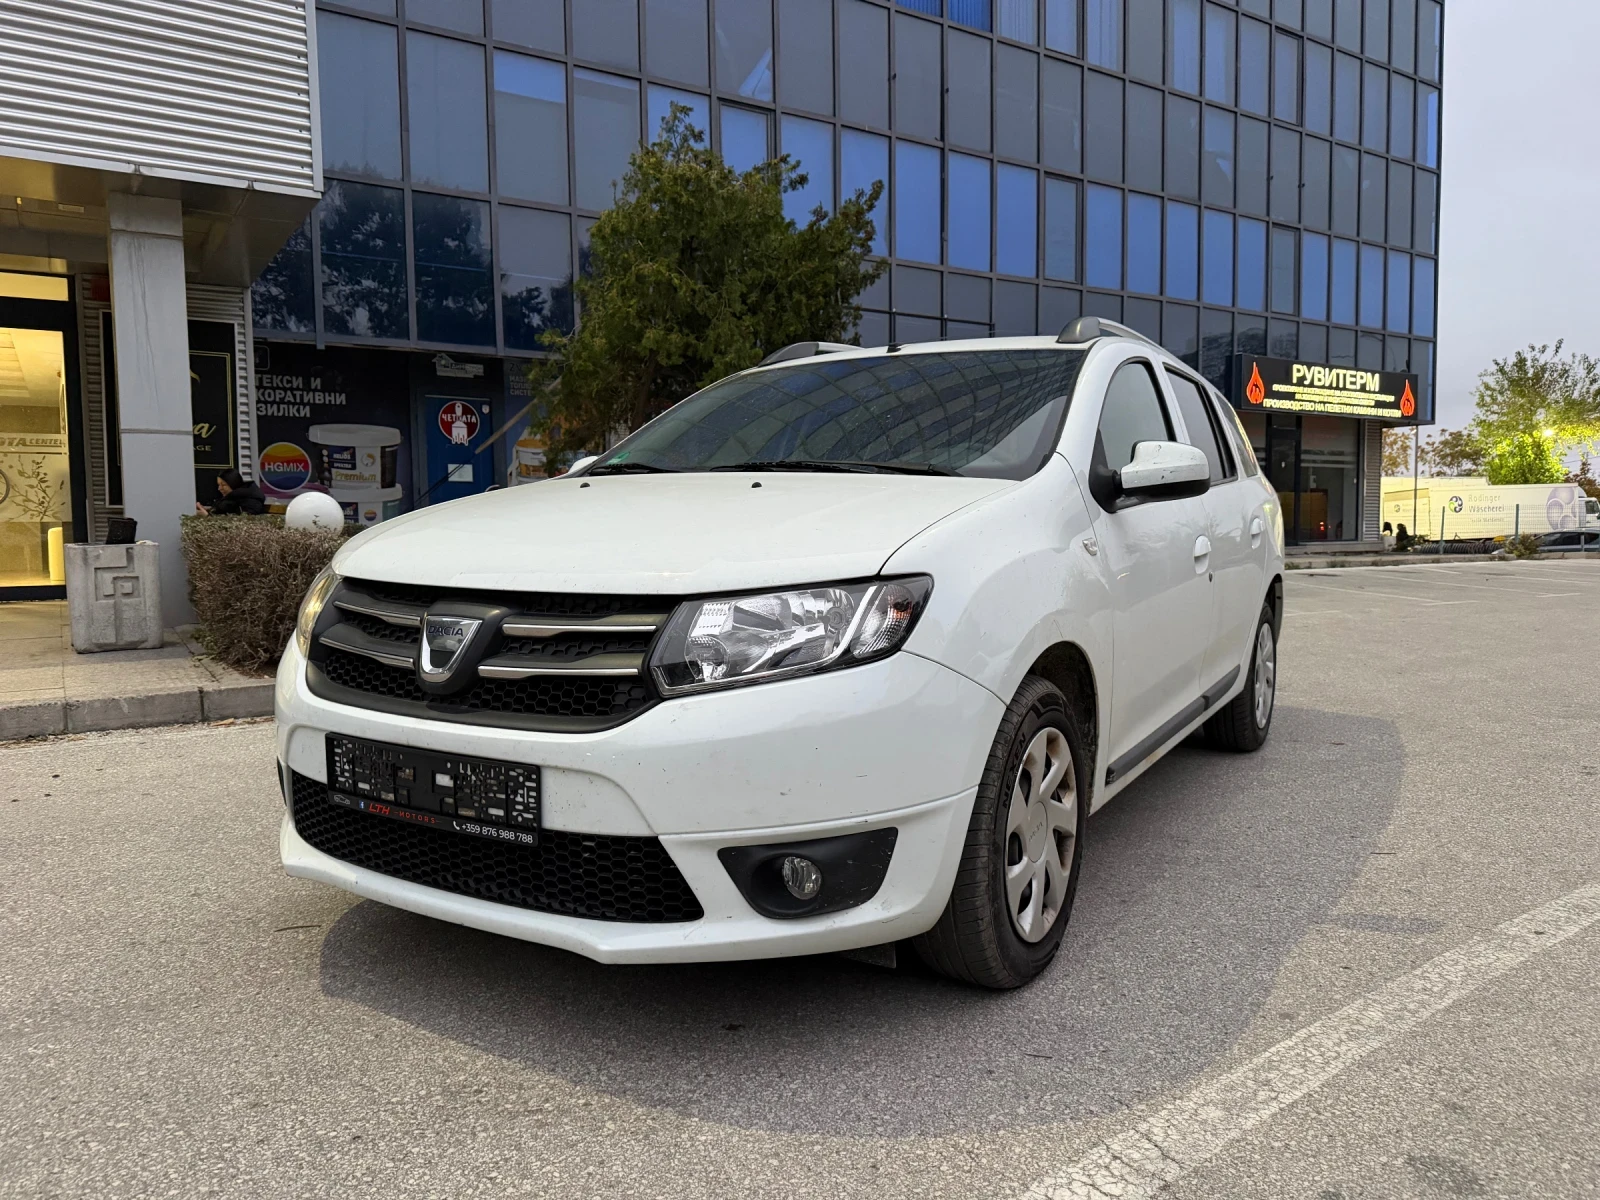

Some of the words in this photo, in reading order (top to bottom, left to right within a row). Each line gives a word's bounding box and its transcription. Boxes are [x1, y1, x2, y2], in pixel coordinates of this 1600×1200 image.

[311, 377, 321, 390] И
[1292, 363, 1380, 392] РУВИТЕРМ
[264, 462, 305, 472] HGMIX
[335, 471, 376, 481] Premium
[428, 625, 463, 637] DACIA
[369, 803, 390, 815] LTH
[462, 823, 480, 834] +359
[482, 826, 497, 837] 876
[499, 829, 515, 840] 988
[516, 832, 533, 844] 788
